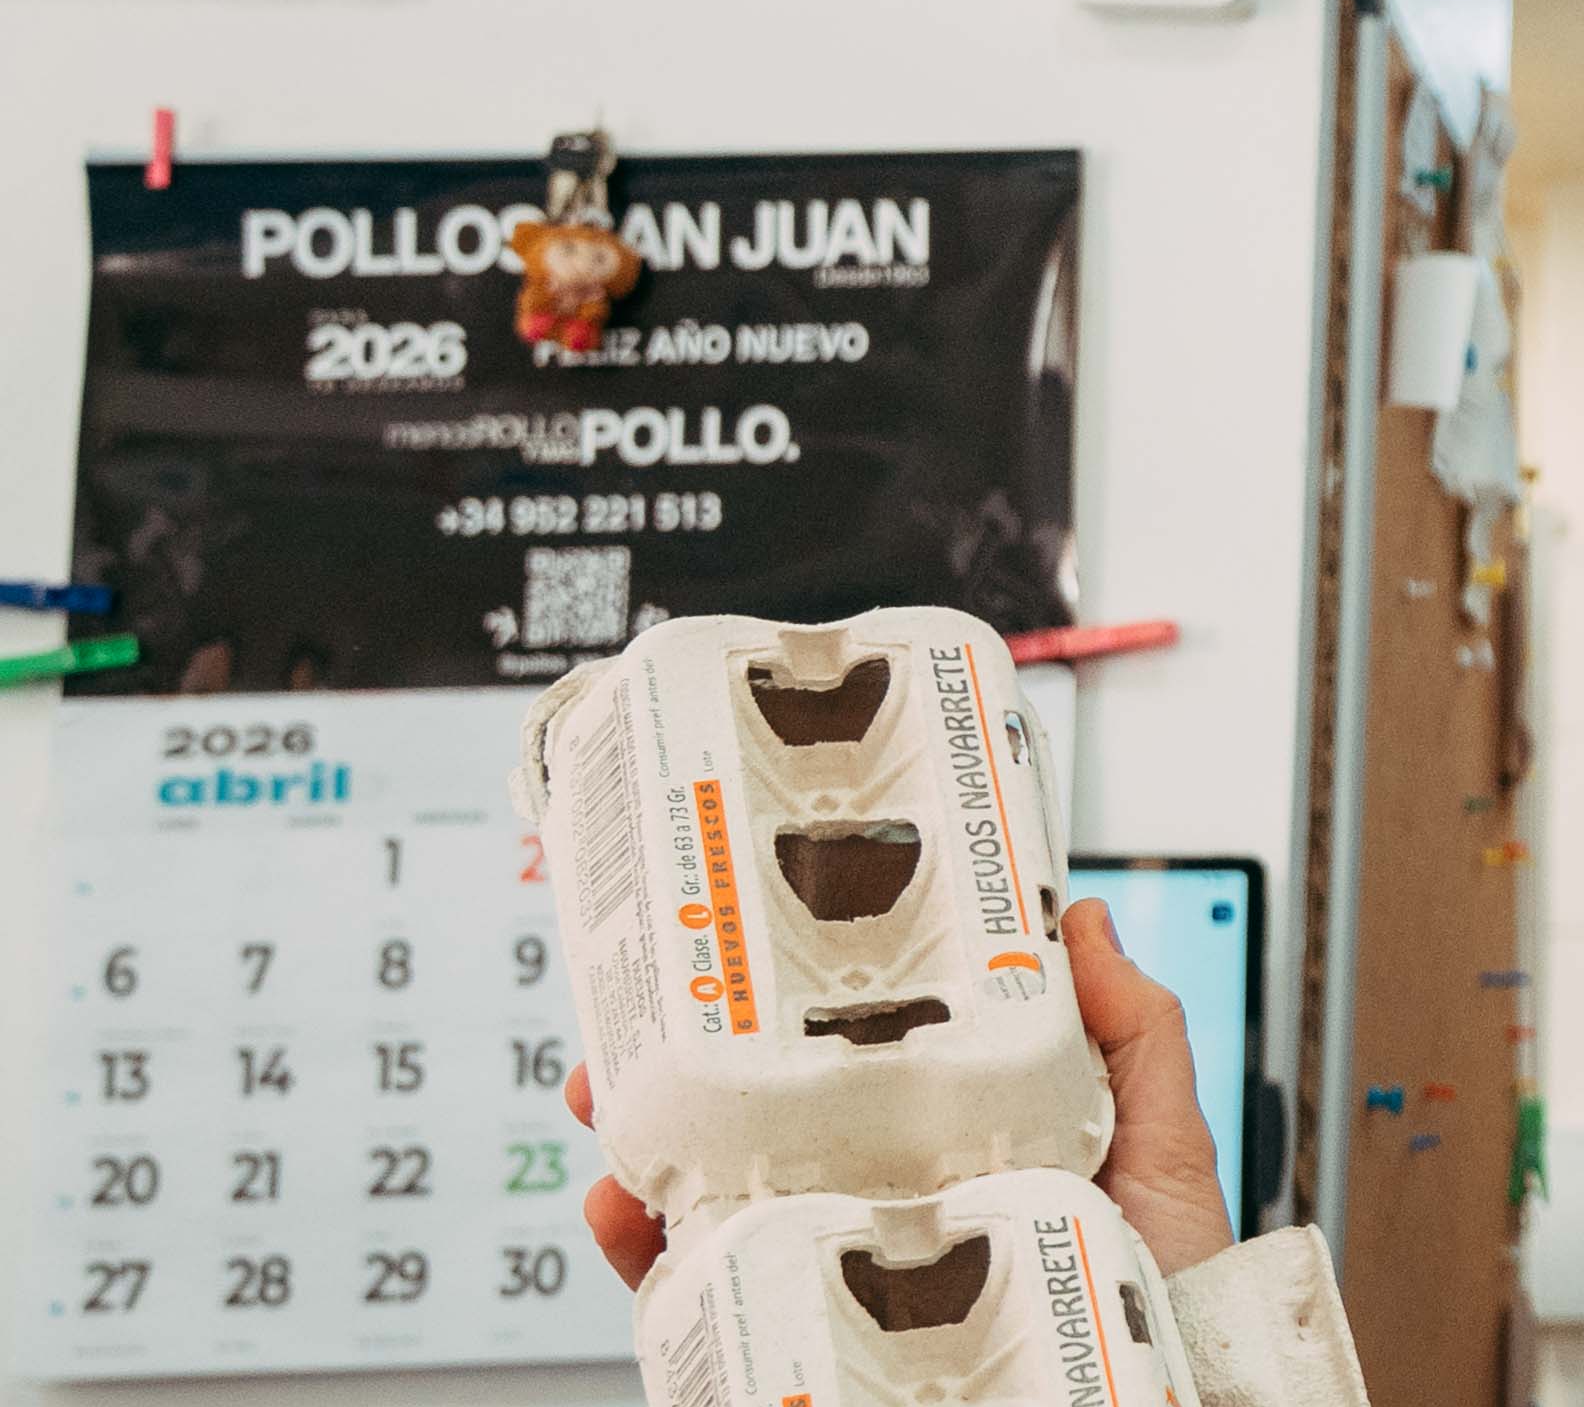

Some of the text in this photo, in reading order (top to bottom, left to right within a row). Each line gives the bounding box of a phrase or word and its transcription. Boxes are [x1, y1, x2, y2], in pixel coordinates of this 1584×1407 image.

[731, 197, 931, 270] JUAN
[304, 321, 468, 382] 2026
[646, 318, 731, 366] AÑO
[735, 321, 869, 364] NUEVO
[647, 675, 660, 704] antes
[160, 722, 317, 759] 2026
[928, 644, 993, 810] NAVARRETE
[655, 731, 671, 779] Consumir
[154, 762, 352, 807] abril
[667, 785, 687, 804] Gr.
[669, 806, 690, 822] 73
[677, 824, 692, 833] a
[382, 833, 546, 885] 1 2
[674, 835, 694, 851] 63
[676, 854, 697, 871] de
[681, 873, 701, 896] Gr.:
[964, 818, 1019, 937] HUEVOS
[687, 910, 709, 920] L
[699, 782, 754, 1031] 6 HUEVOS FRESCOS
[104, 935, 549, 997] 6 7 8 9
[696, 981, 719, 995] A
[702, 1003, 723, 1034] Cat.:
[99, 1036, 566, 1103] 13 14 15 16
[89, 1140, 569, 1209] 20 21 22 23
[80, 1247, 569, 1314] 27 28 29 30
[730, 1274, 745, 1308] antes
[743, 1340, 759, 1396] Consumir
